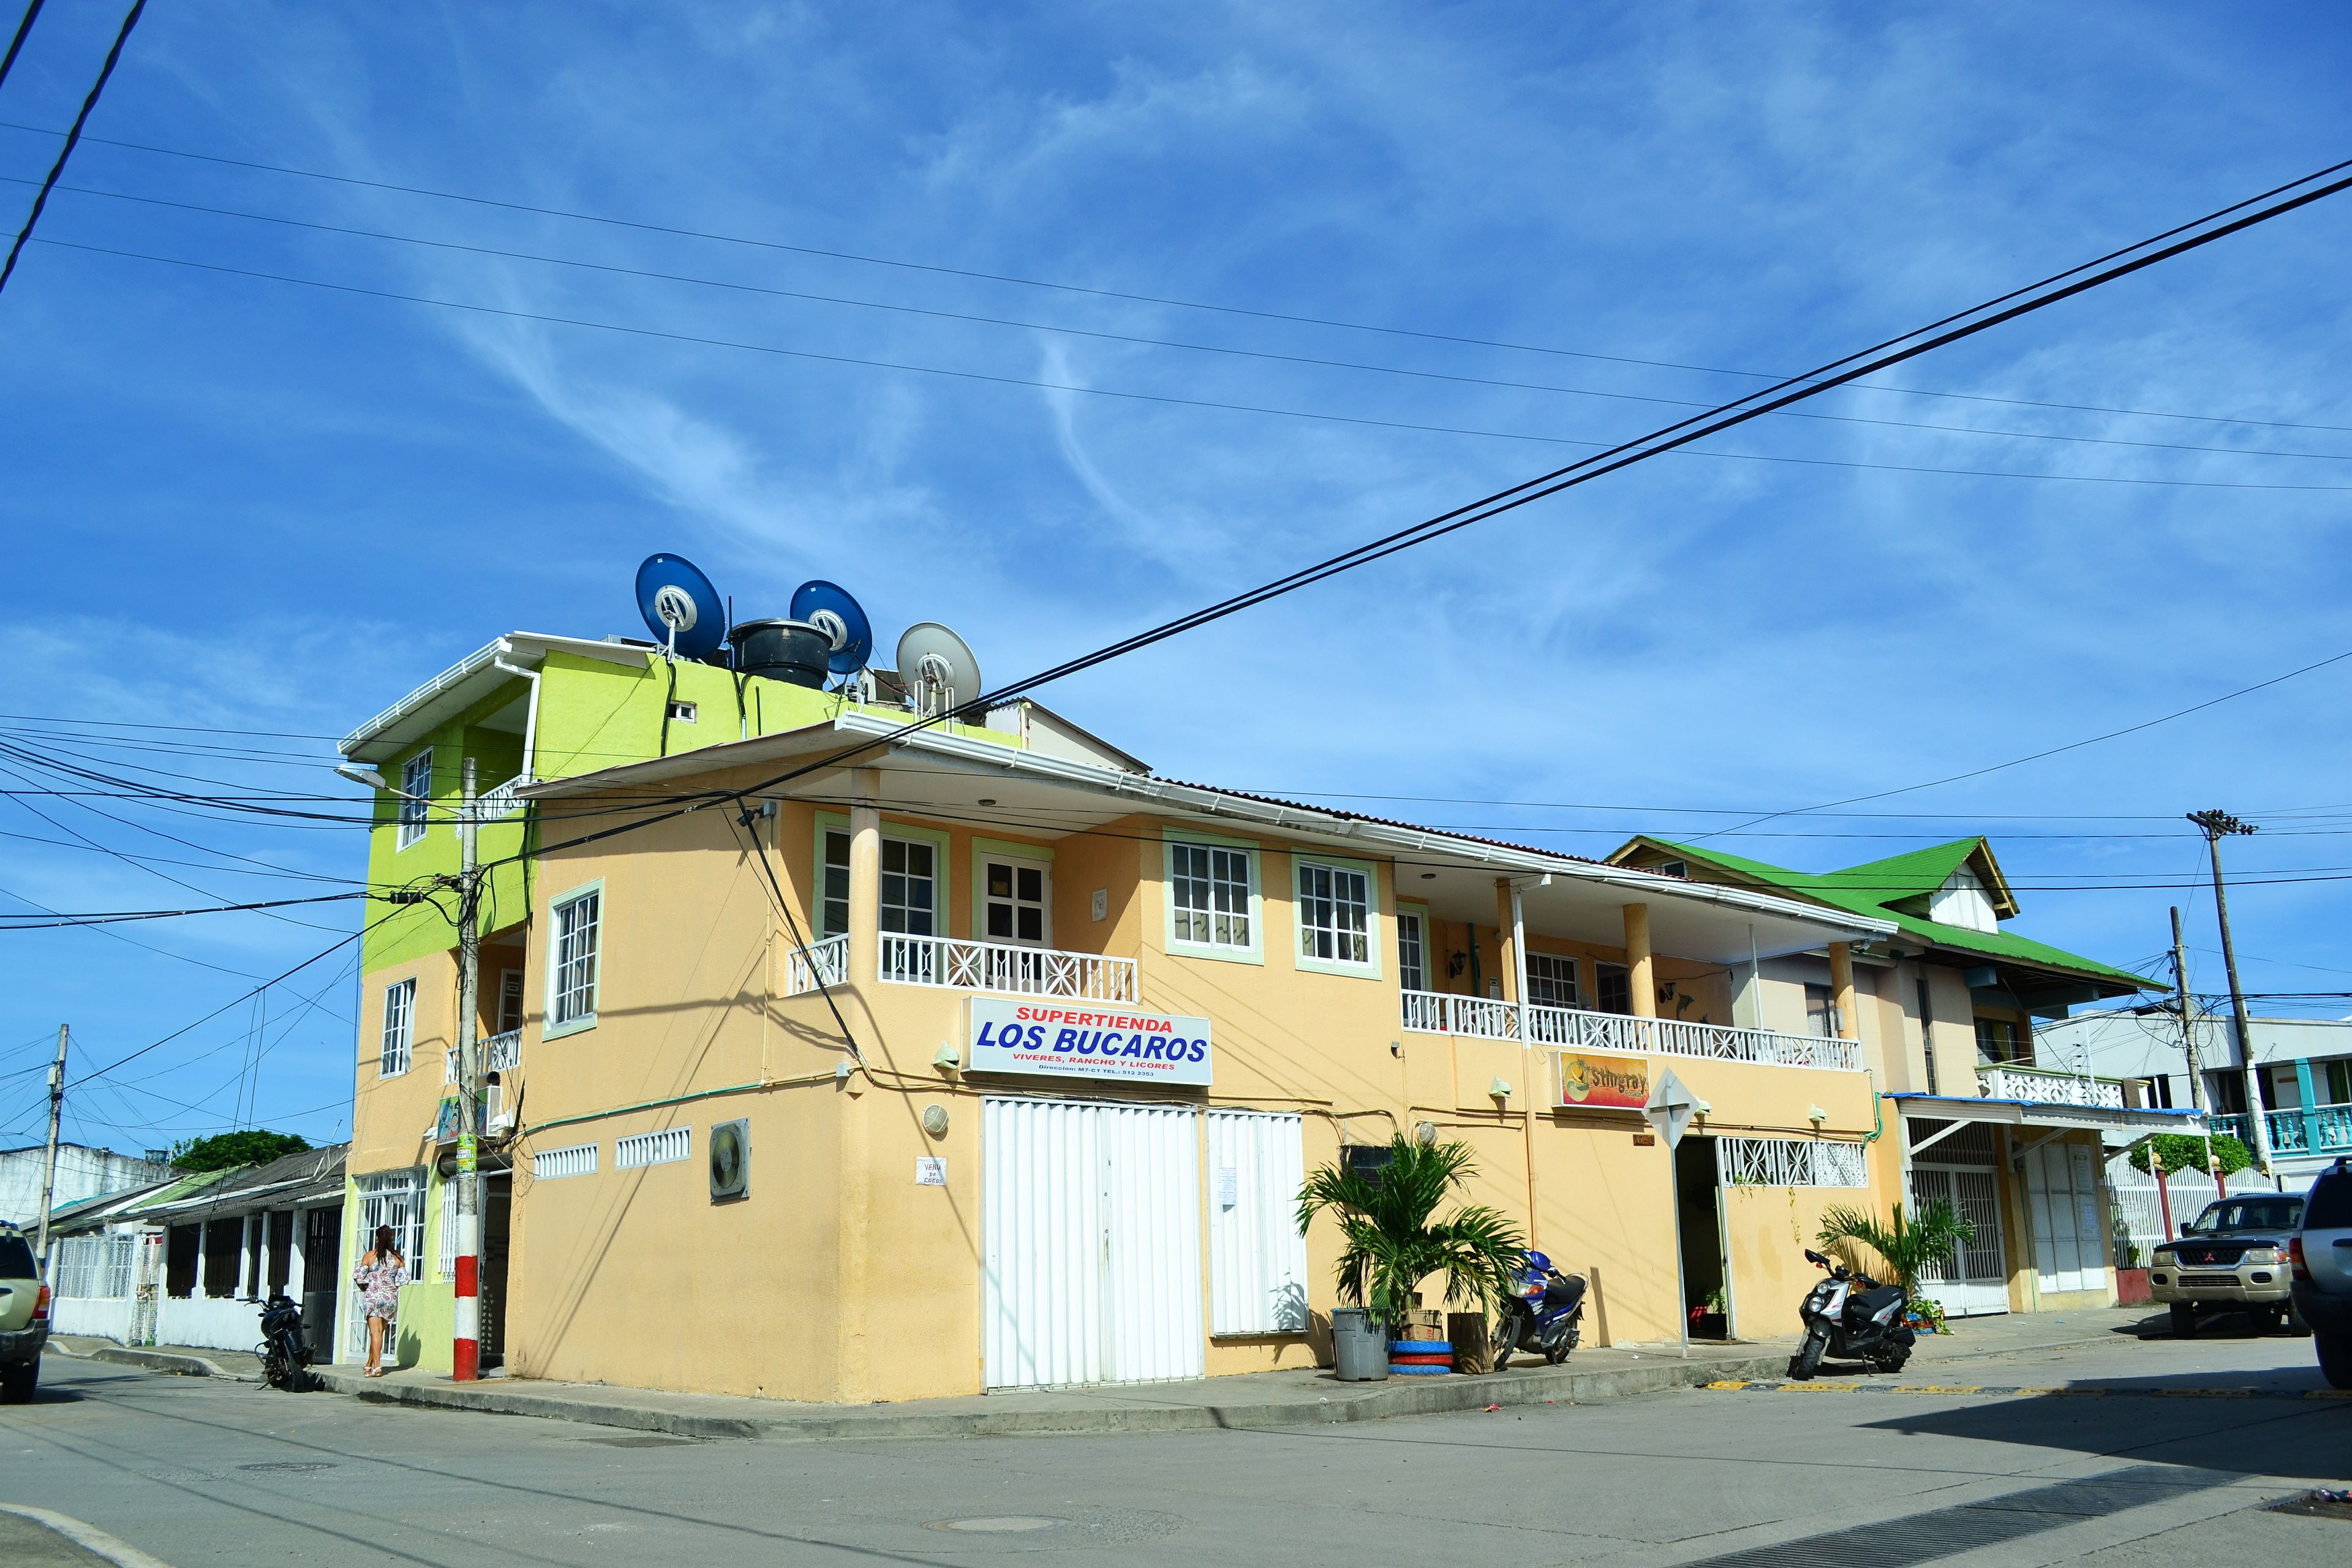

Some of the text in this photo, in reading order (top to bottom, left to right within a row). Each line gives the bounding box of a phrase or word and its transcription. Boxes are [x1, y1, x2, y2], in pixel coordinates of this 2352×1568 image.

[1016, 1007, 1172, 1033] SUPERTIENDA
[977, 1022, 1207, 1063] LOS BUCAROS
[1013, 1054, 1065, 1064] VIVERES,
[1069, 1057, 1116, 1066] RANCHO
[1130, 1061, 1175, 1071] LICORES
[1591, 1066, 1646, 1095] Stingray
